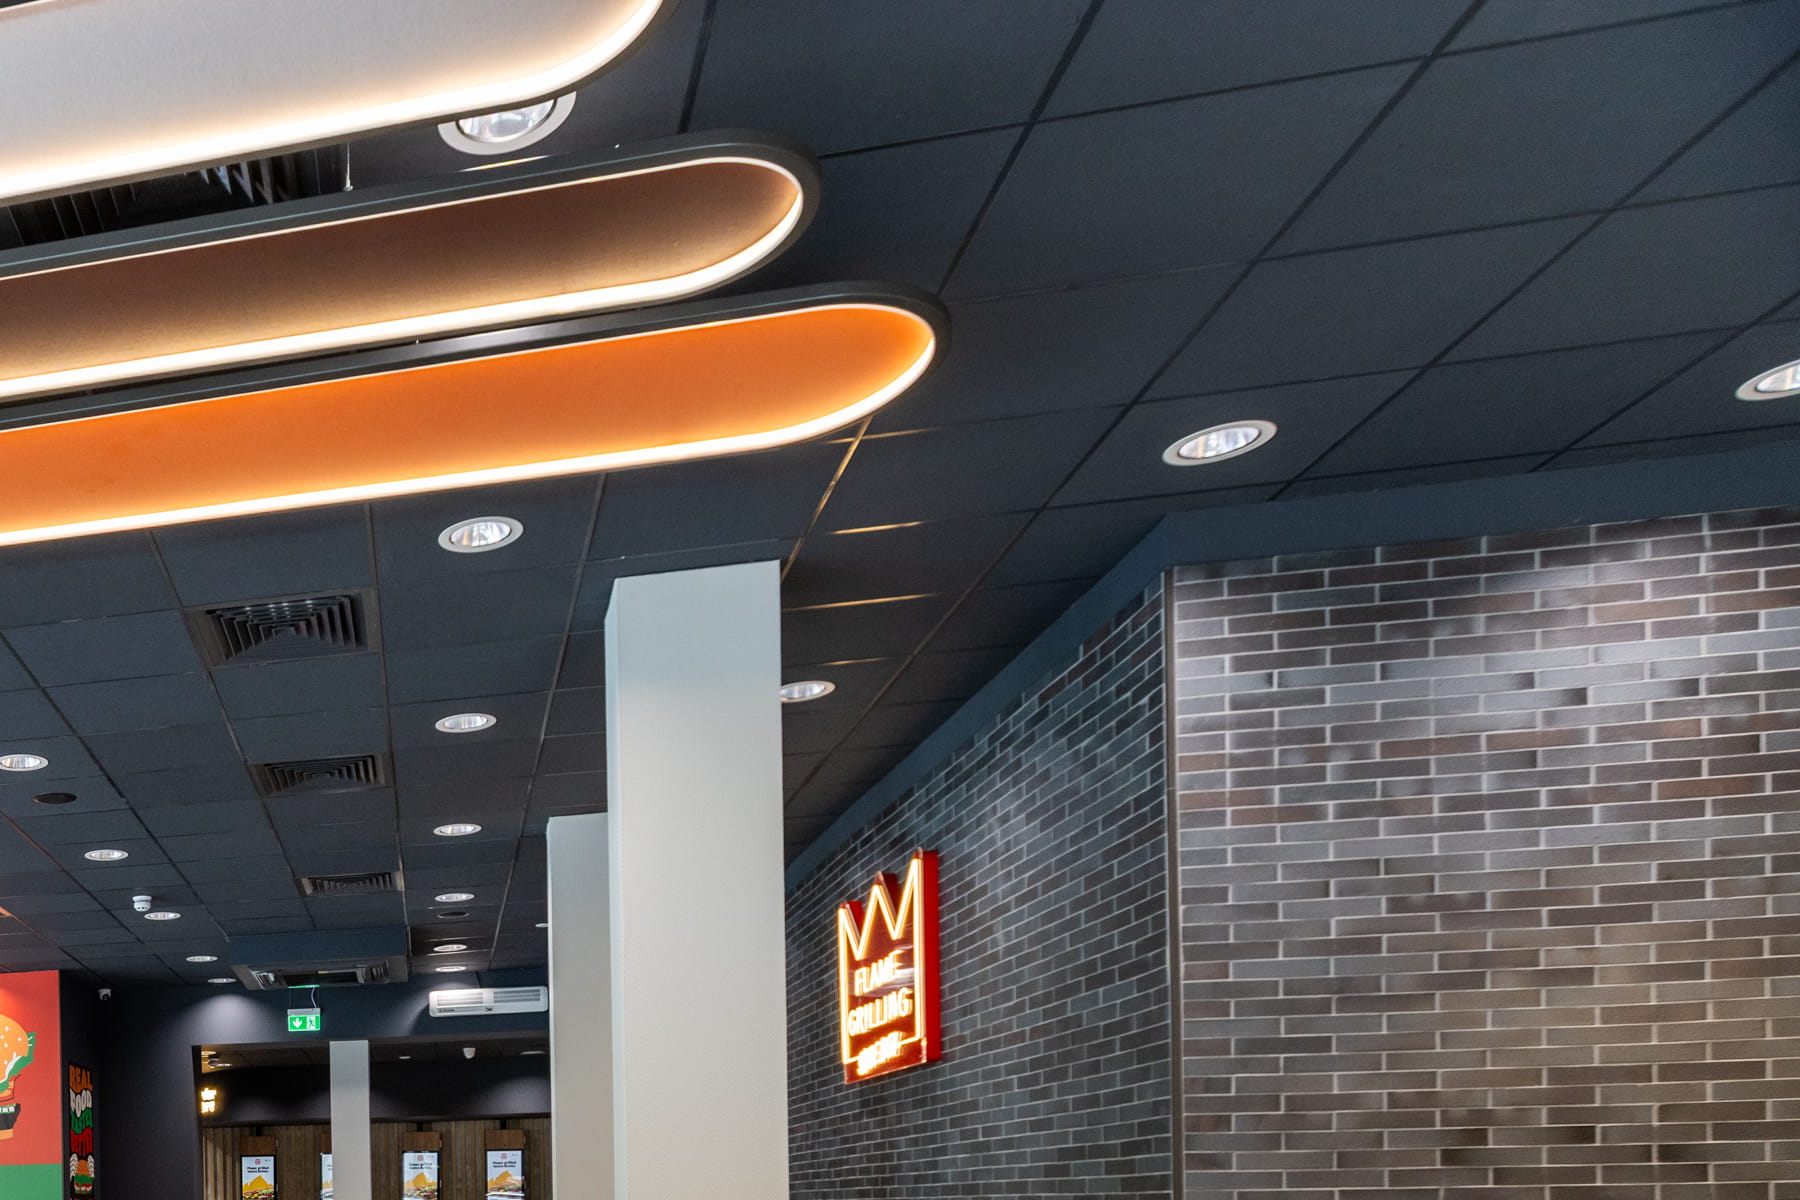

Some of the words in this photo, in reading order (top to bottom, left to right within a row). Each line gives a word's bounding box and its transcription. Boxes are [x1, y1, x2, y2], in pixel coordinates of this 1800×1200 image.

[854, 950, 904, 996] FLAME
[848, 987, 912, 1036] GRILLING
[69, 1065, 92, 1094] REAL
[70, 1088, 92, 1118] FOOD
